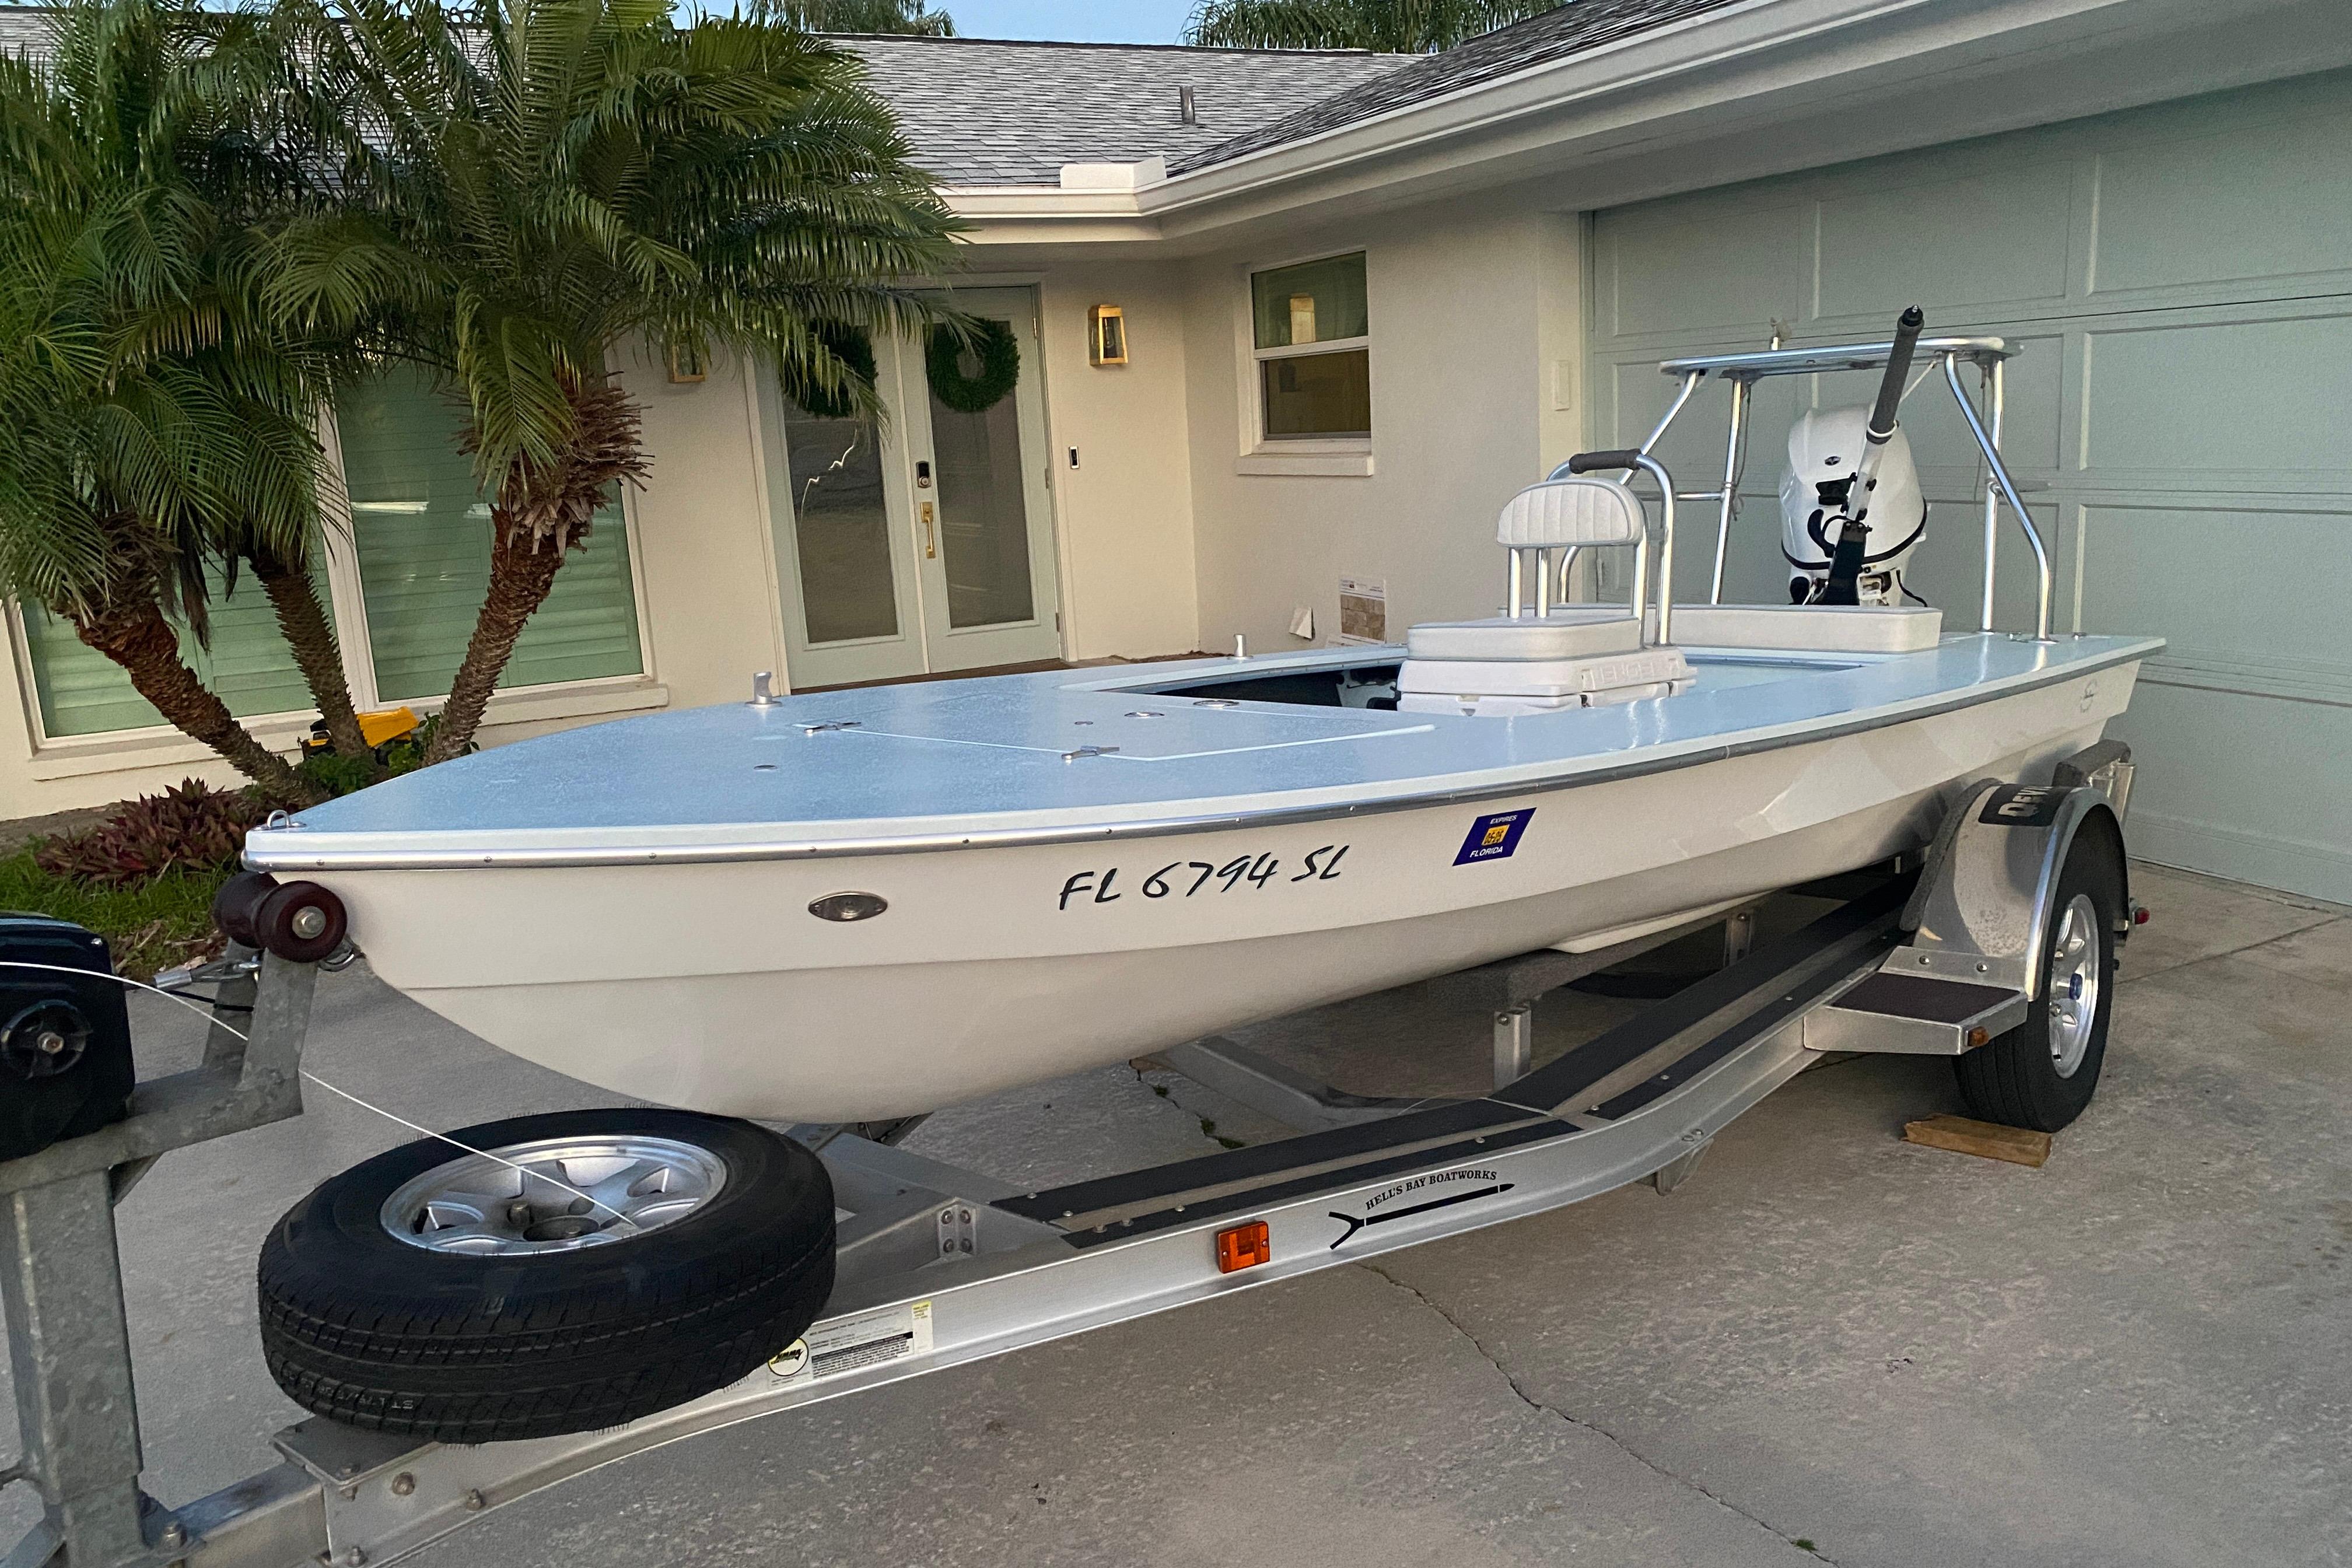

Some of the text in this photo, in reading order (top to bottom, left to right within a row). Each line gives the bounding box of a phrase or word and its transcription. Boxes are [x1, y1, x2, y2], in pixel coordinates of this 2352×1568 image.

[1490, 815, 1517, 824] EXPIRES
[1469, 846, 1503, 858] FLORIDA
[1059, 845, 1350, 911] FL 6794 SL
[1365, 1170, 1497, 1210] HELL'S BAY BOATWORKS
